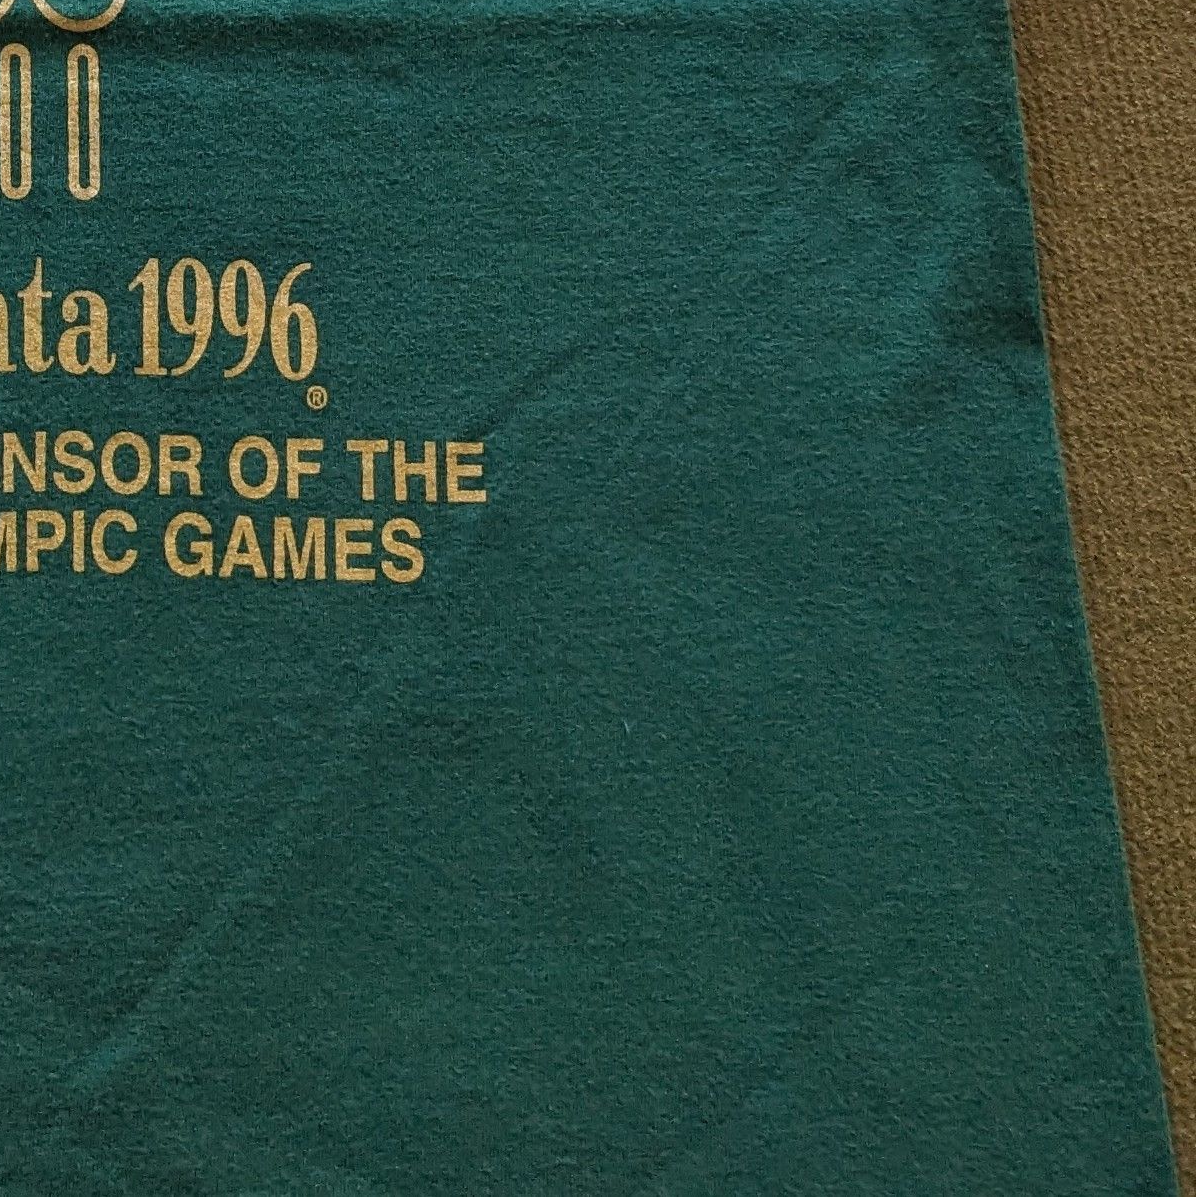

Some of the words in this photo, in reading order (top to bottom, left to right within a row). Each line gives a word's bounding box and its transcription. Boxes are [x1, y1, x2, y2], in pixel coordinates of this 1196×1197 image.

[130, 257, 319, 381] 1996
[228, 435, 324, 500] OF
[346, 439, 487, 503] THE
[163, 511, 425, 583] GAMES
